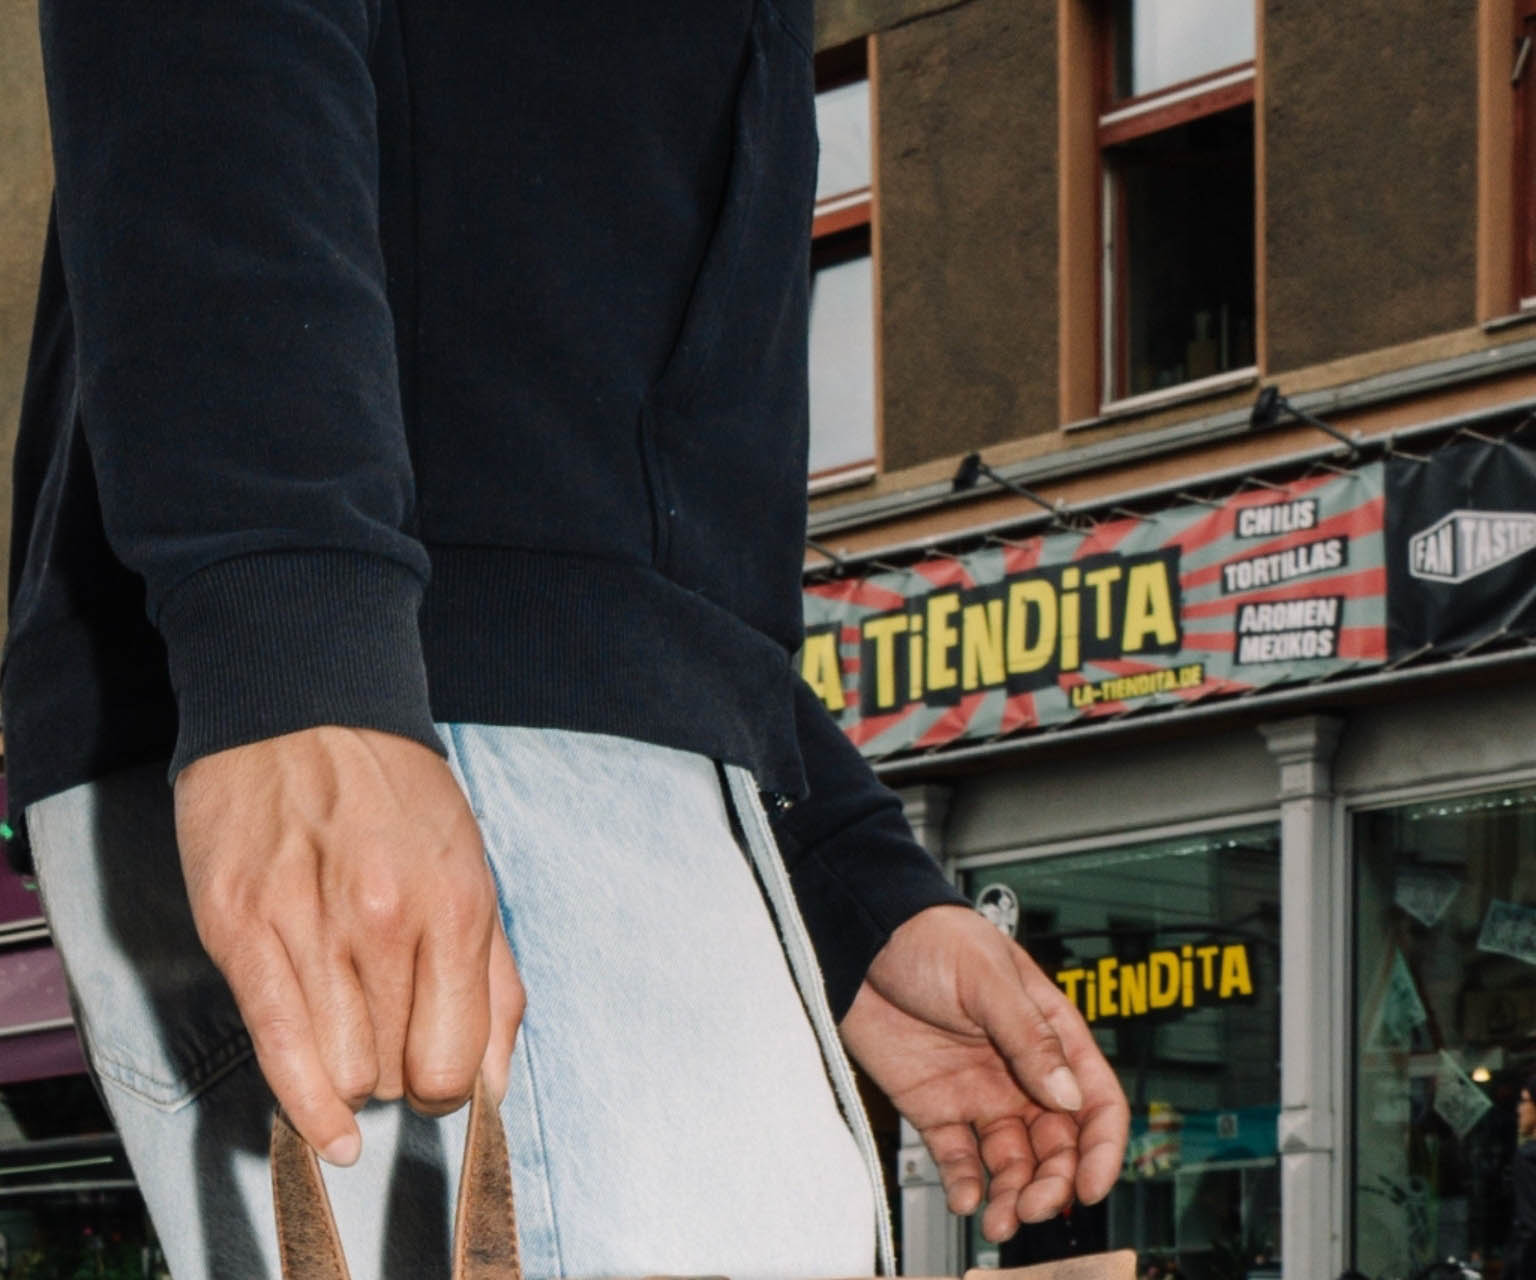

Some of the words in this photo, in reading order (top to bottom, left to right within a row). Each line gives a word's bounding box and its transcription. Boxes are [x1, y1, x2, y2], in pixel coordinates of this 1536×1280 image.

[1239, 500, 1315, 537] CHILIS
[1224, 539, 1342, 591] TORTILLAS
[1239, 598, 1338, 633] AROMEN
[1238, 629, 1335, 664] MEXIKOS
[1072, 664, 1202, 708] LA-TIENDITA.DE
